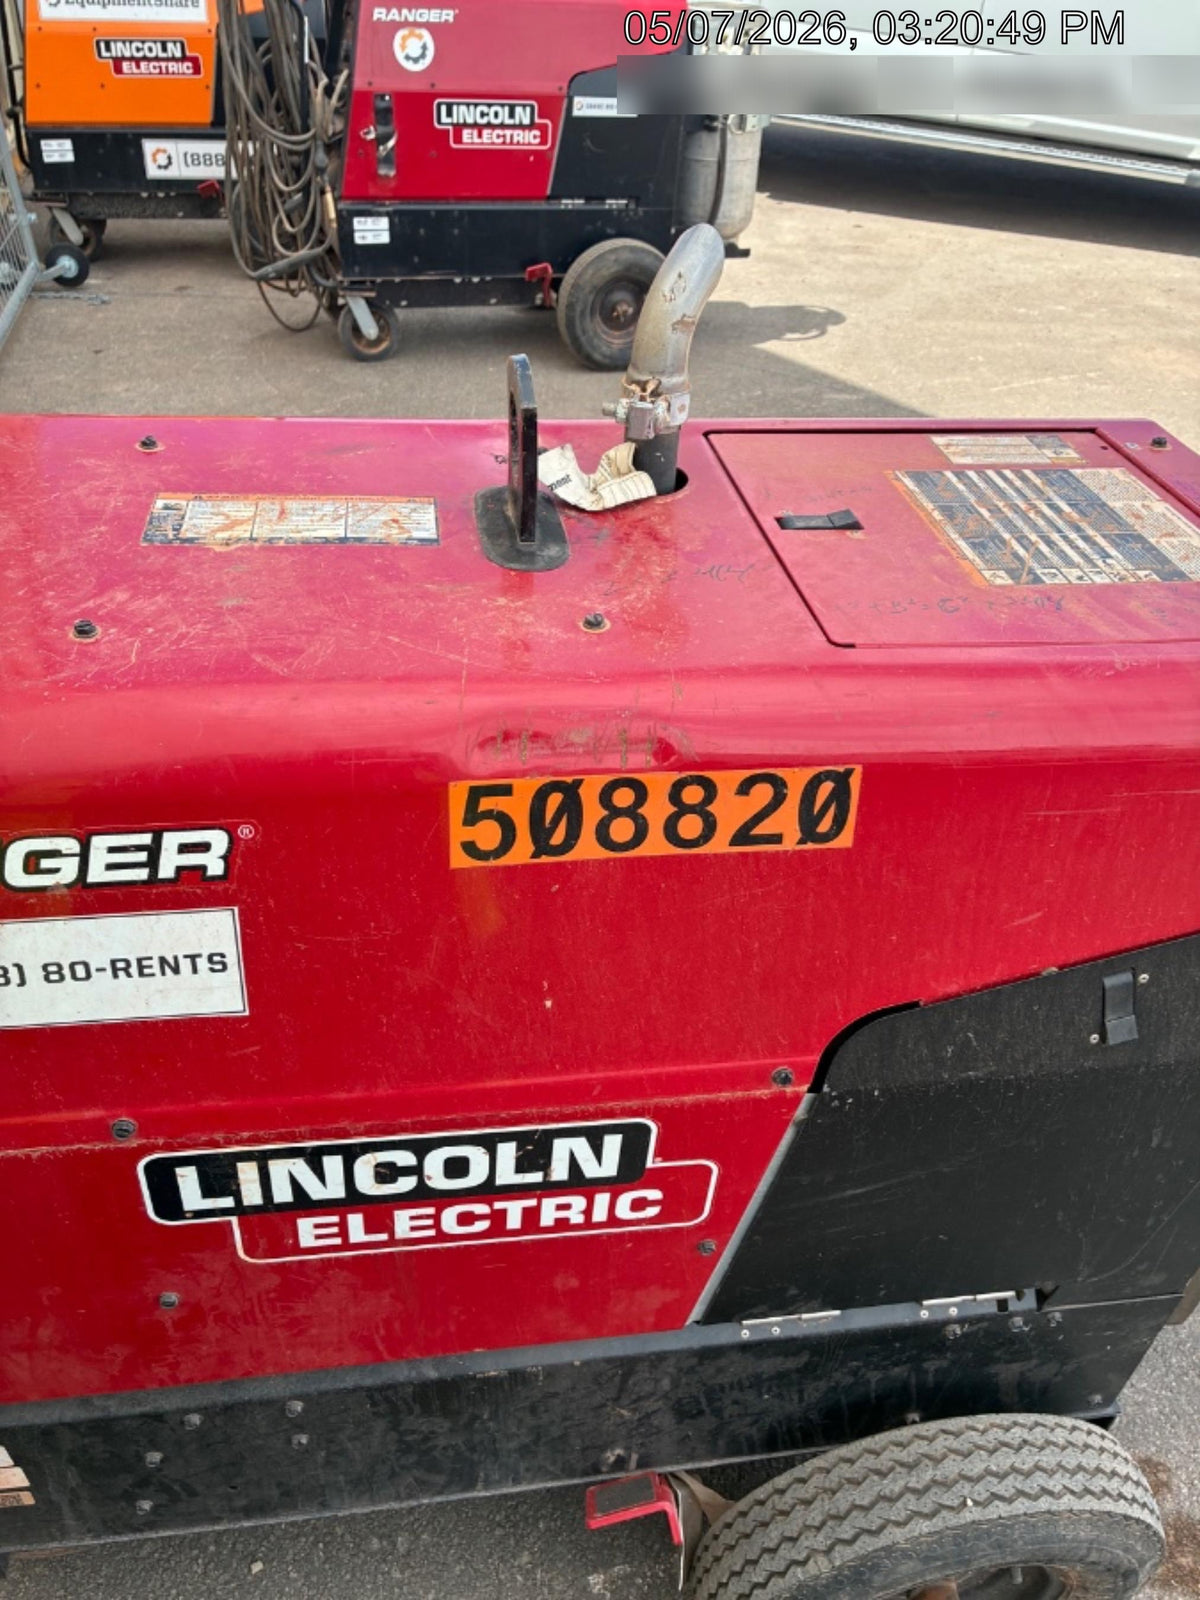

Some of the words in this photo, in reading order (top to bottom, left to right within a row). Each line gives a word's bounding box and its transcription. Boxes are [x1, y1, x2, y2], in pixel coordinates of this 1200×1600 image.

[372, 7, 455, 23] RANGER
[99, 41, 182, 58] LINCOLN
[122, 61, 194, 74] ELECTRIC
[440, 104, 531, 125] LINCOLN
[462, 129, 541, 144] ELECTRIC
[459, 767, 856, 862] 508820
[41, 952, 229, 984] 80-RENTS
[173, 1133, 624, 1212] LINCOLN
[296, 1187, 663, 1250] ELECTRIC
